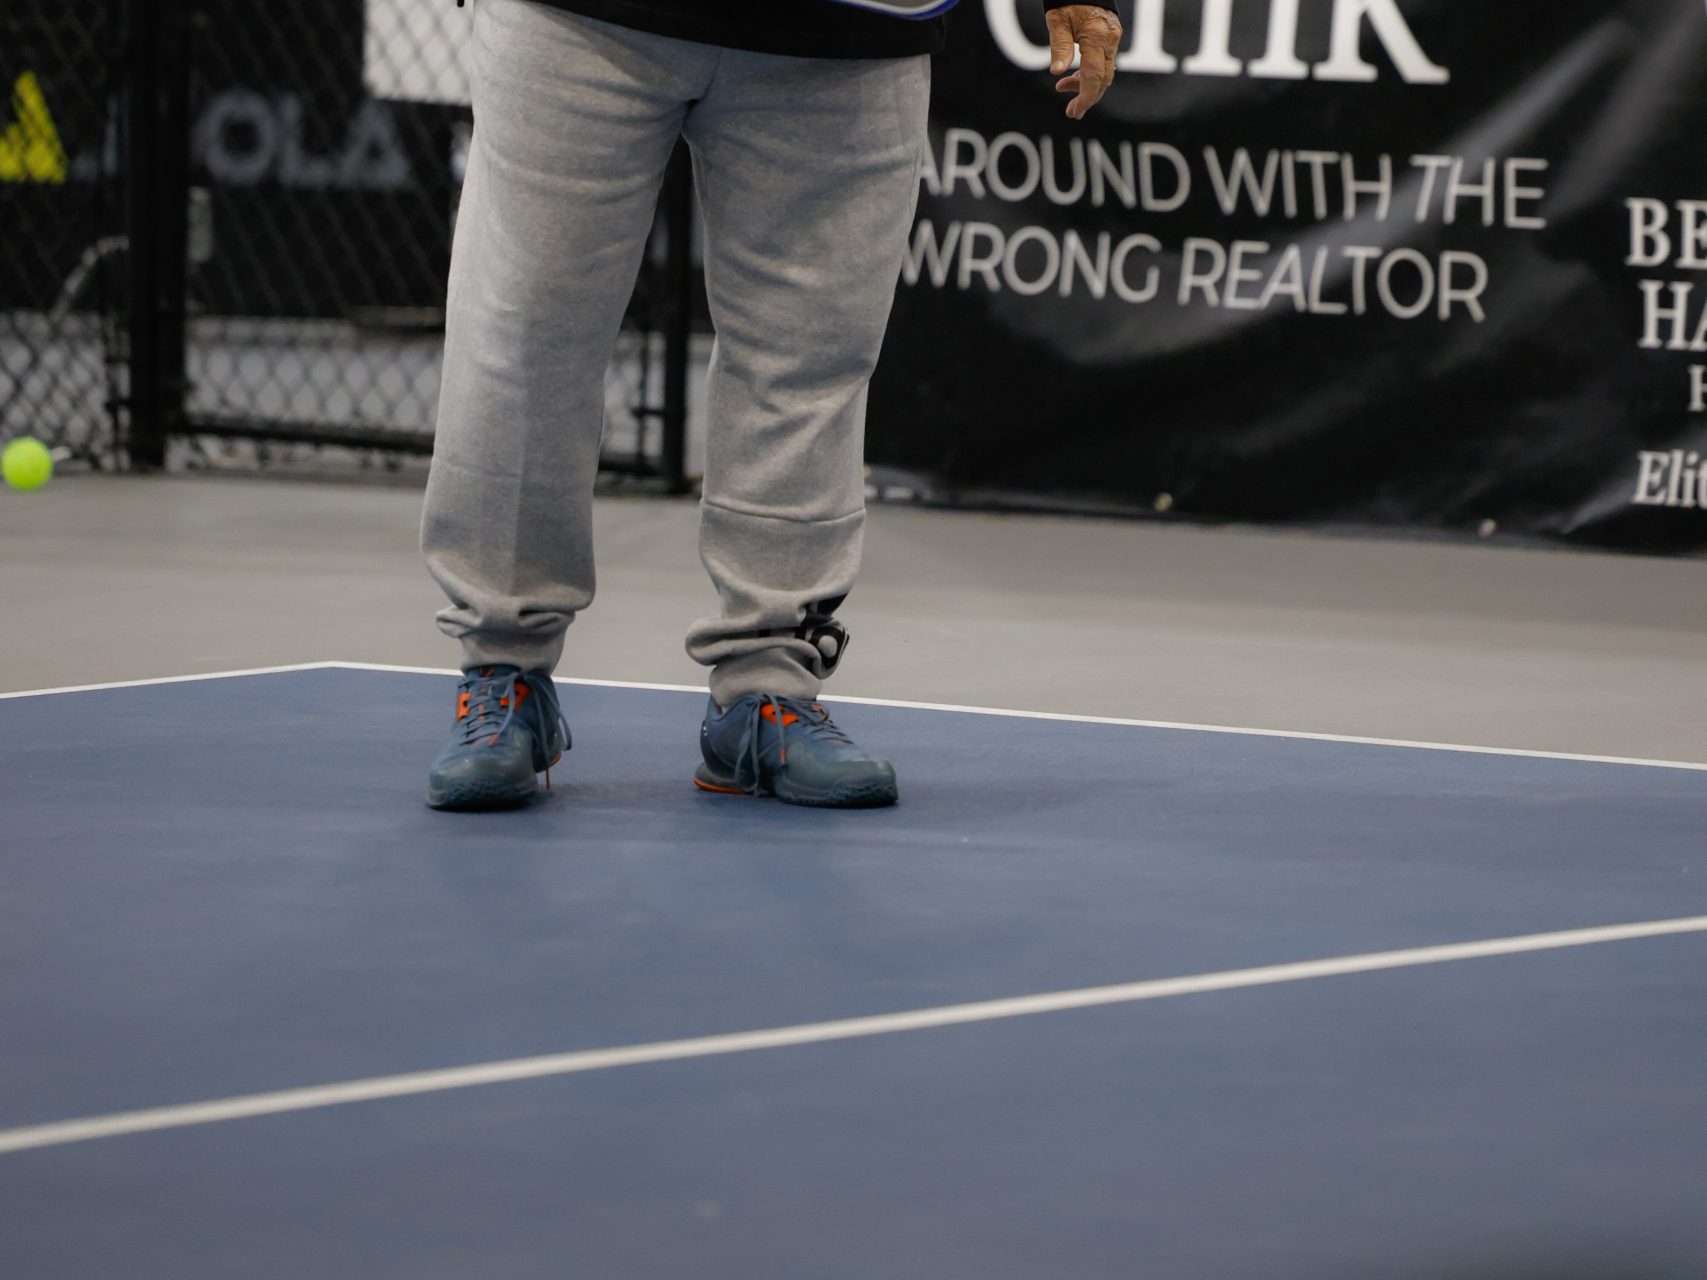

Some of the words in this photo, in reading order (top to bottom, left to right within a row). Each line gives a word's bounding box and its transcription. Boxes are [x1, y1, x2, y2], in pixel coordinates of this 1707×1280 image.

[1203, 144, 1393, 220] WITH
[1409, 152, 1549, 229] THE
[901, 219, 1162, 303] WRONG
[1177, 236, 1486, 323] REALTOR
